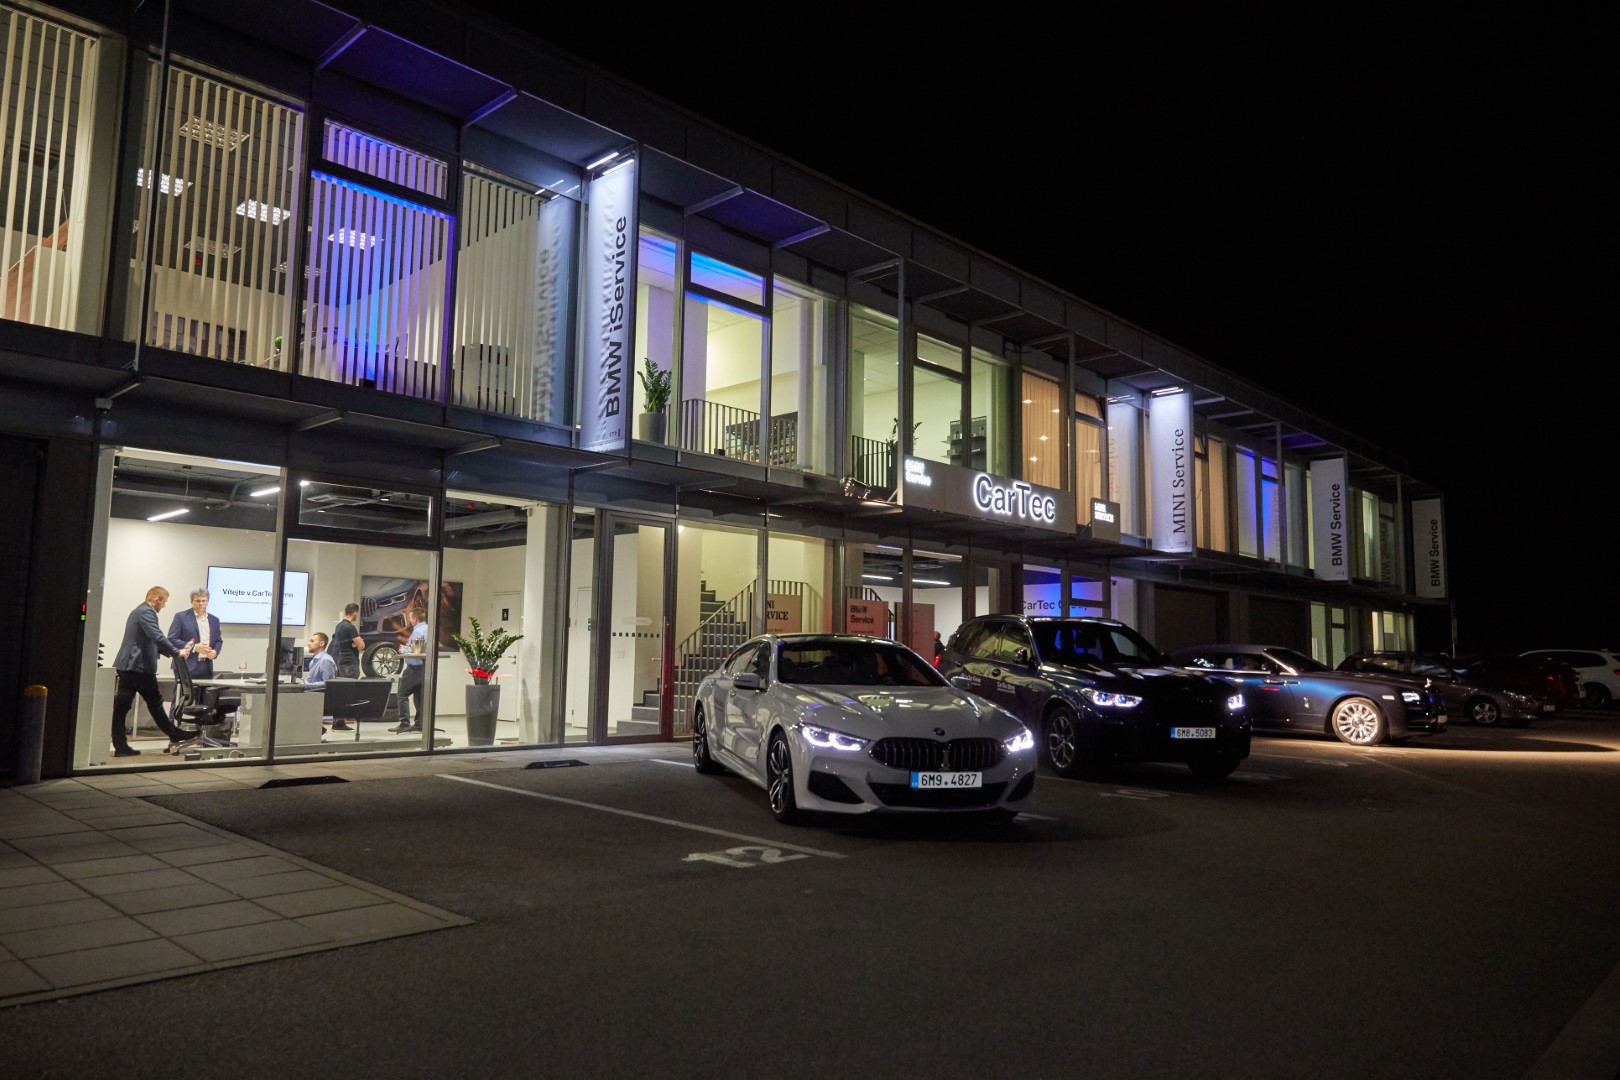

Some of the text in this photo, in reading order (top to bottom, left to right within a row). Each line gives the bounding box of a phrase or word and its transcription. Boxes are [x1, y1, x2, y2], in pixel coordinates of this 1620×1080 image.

[605, 216, 627, 417] BMW iService
[1172, 428, 1185, 488] Service
[974, 474, 1056, 521] CarTec
[1172, 493, 1186, 534] MINI
[1330, 483, 1341, 530] Service
[1330, 533, 1343, 566] BMW
[1429, 519, 1440, 587] BMW Service
[921, 774, 977, 786] 6M9 4827
[681, 845, 812, 869] 12
